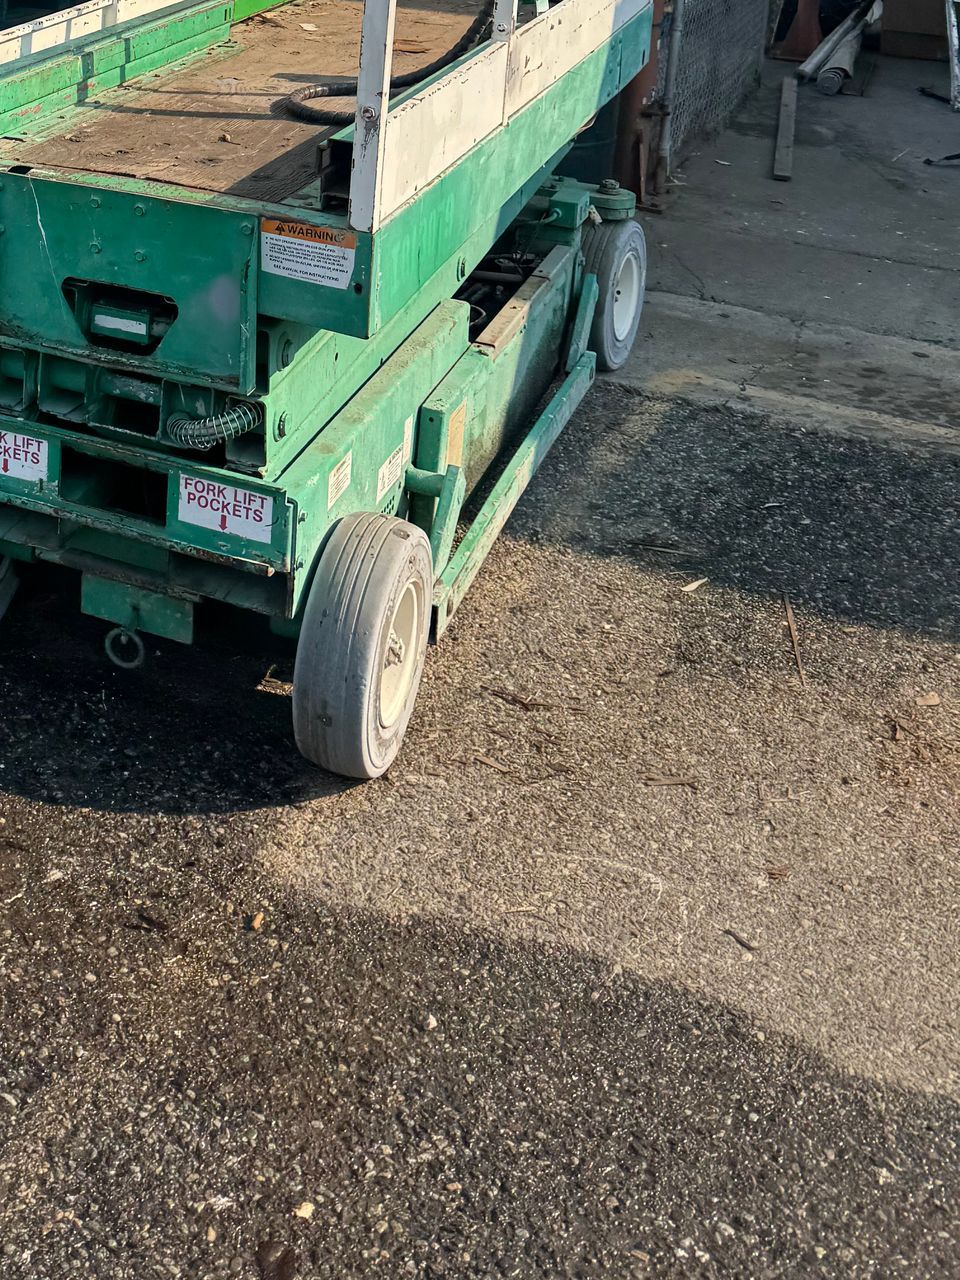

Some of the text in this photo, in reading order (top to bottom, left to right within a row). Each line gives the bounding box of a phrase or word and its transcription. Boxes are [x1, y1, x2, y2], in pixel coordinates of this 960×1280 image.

[13, 434, 44, 452] LIFT
[184, 477, 268, 510] FORK LIFT
[187, 492, 264, 523] POCKETS
